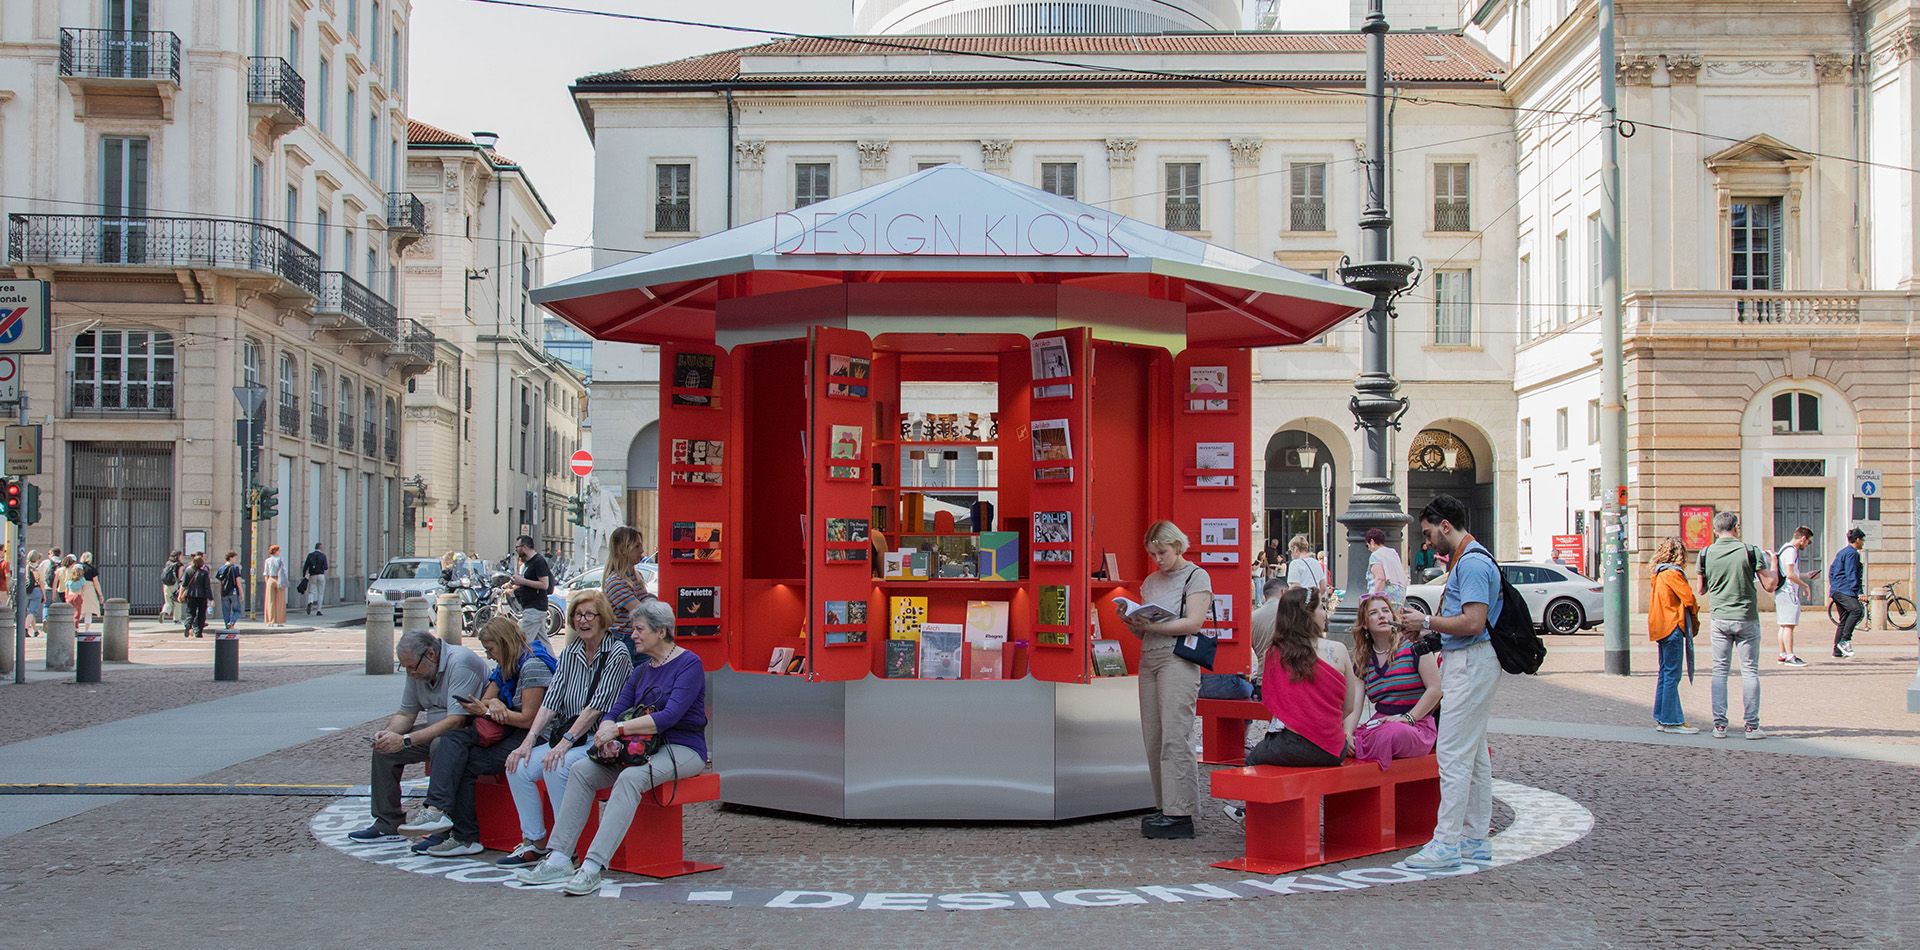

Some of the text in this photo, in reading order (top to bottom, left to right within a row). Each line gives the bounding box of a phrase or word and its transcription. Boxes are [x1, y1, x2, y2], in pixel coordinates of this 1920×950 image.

[773, 212, 1129, 256] DESIGN KIOSK
[1042, 513, 1067, 524] PIN-UP
[680, 588, 713, 596] Serviette
[764, 858, 1500, 911] DESIGN KIOS
